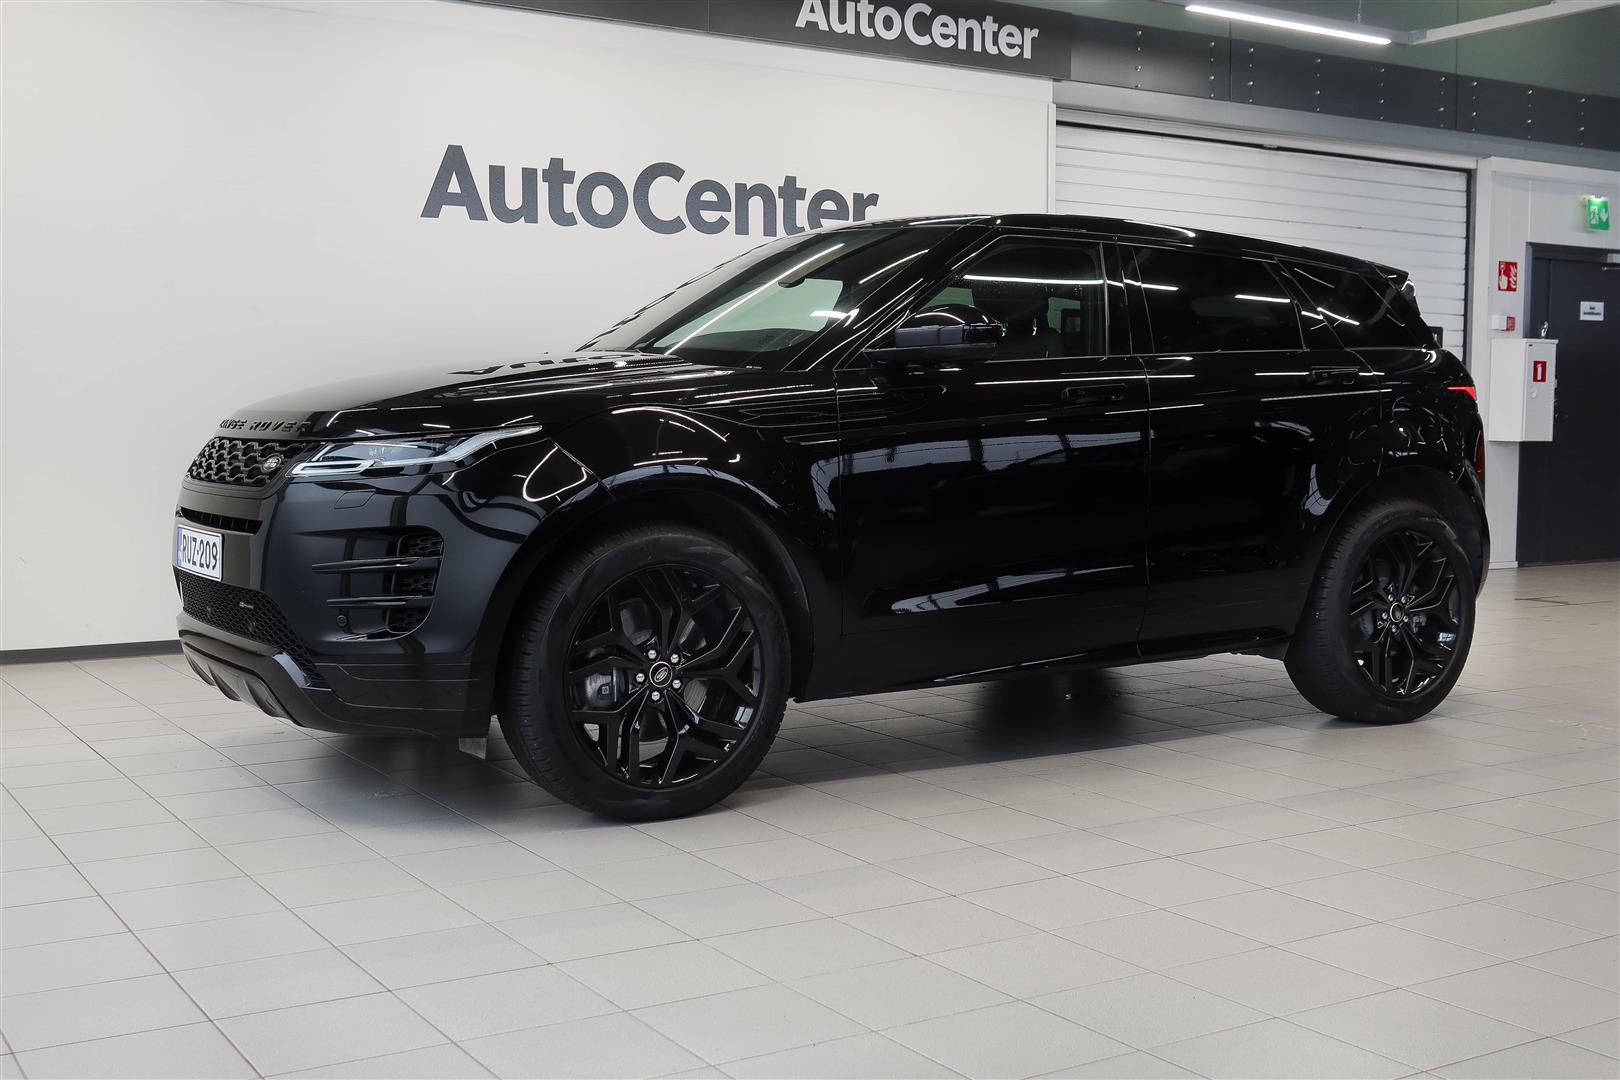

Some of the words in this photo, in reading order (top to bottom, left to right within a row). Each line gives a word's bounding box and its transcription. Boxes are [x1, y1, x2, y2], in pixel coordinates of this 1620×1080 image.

[795, 0, 1039, 59] AutoCenter
[420, 144, 879, 237] AutoCenter
[249, 421, 312, 433] ROVER
[182, 534, 218, 571] RUZ-209
